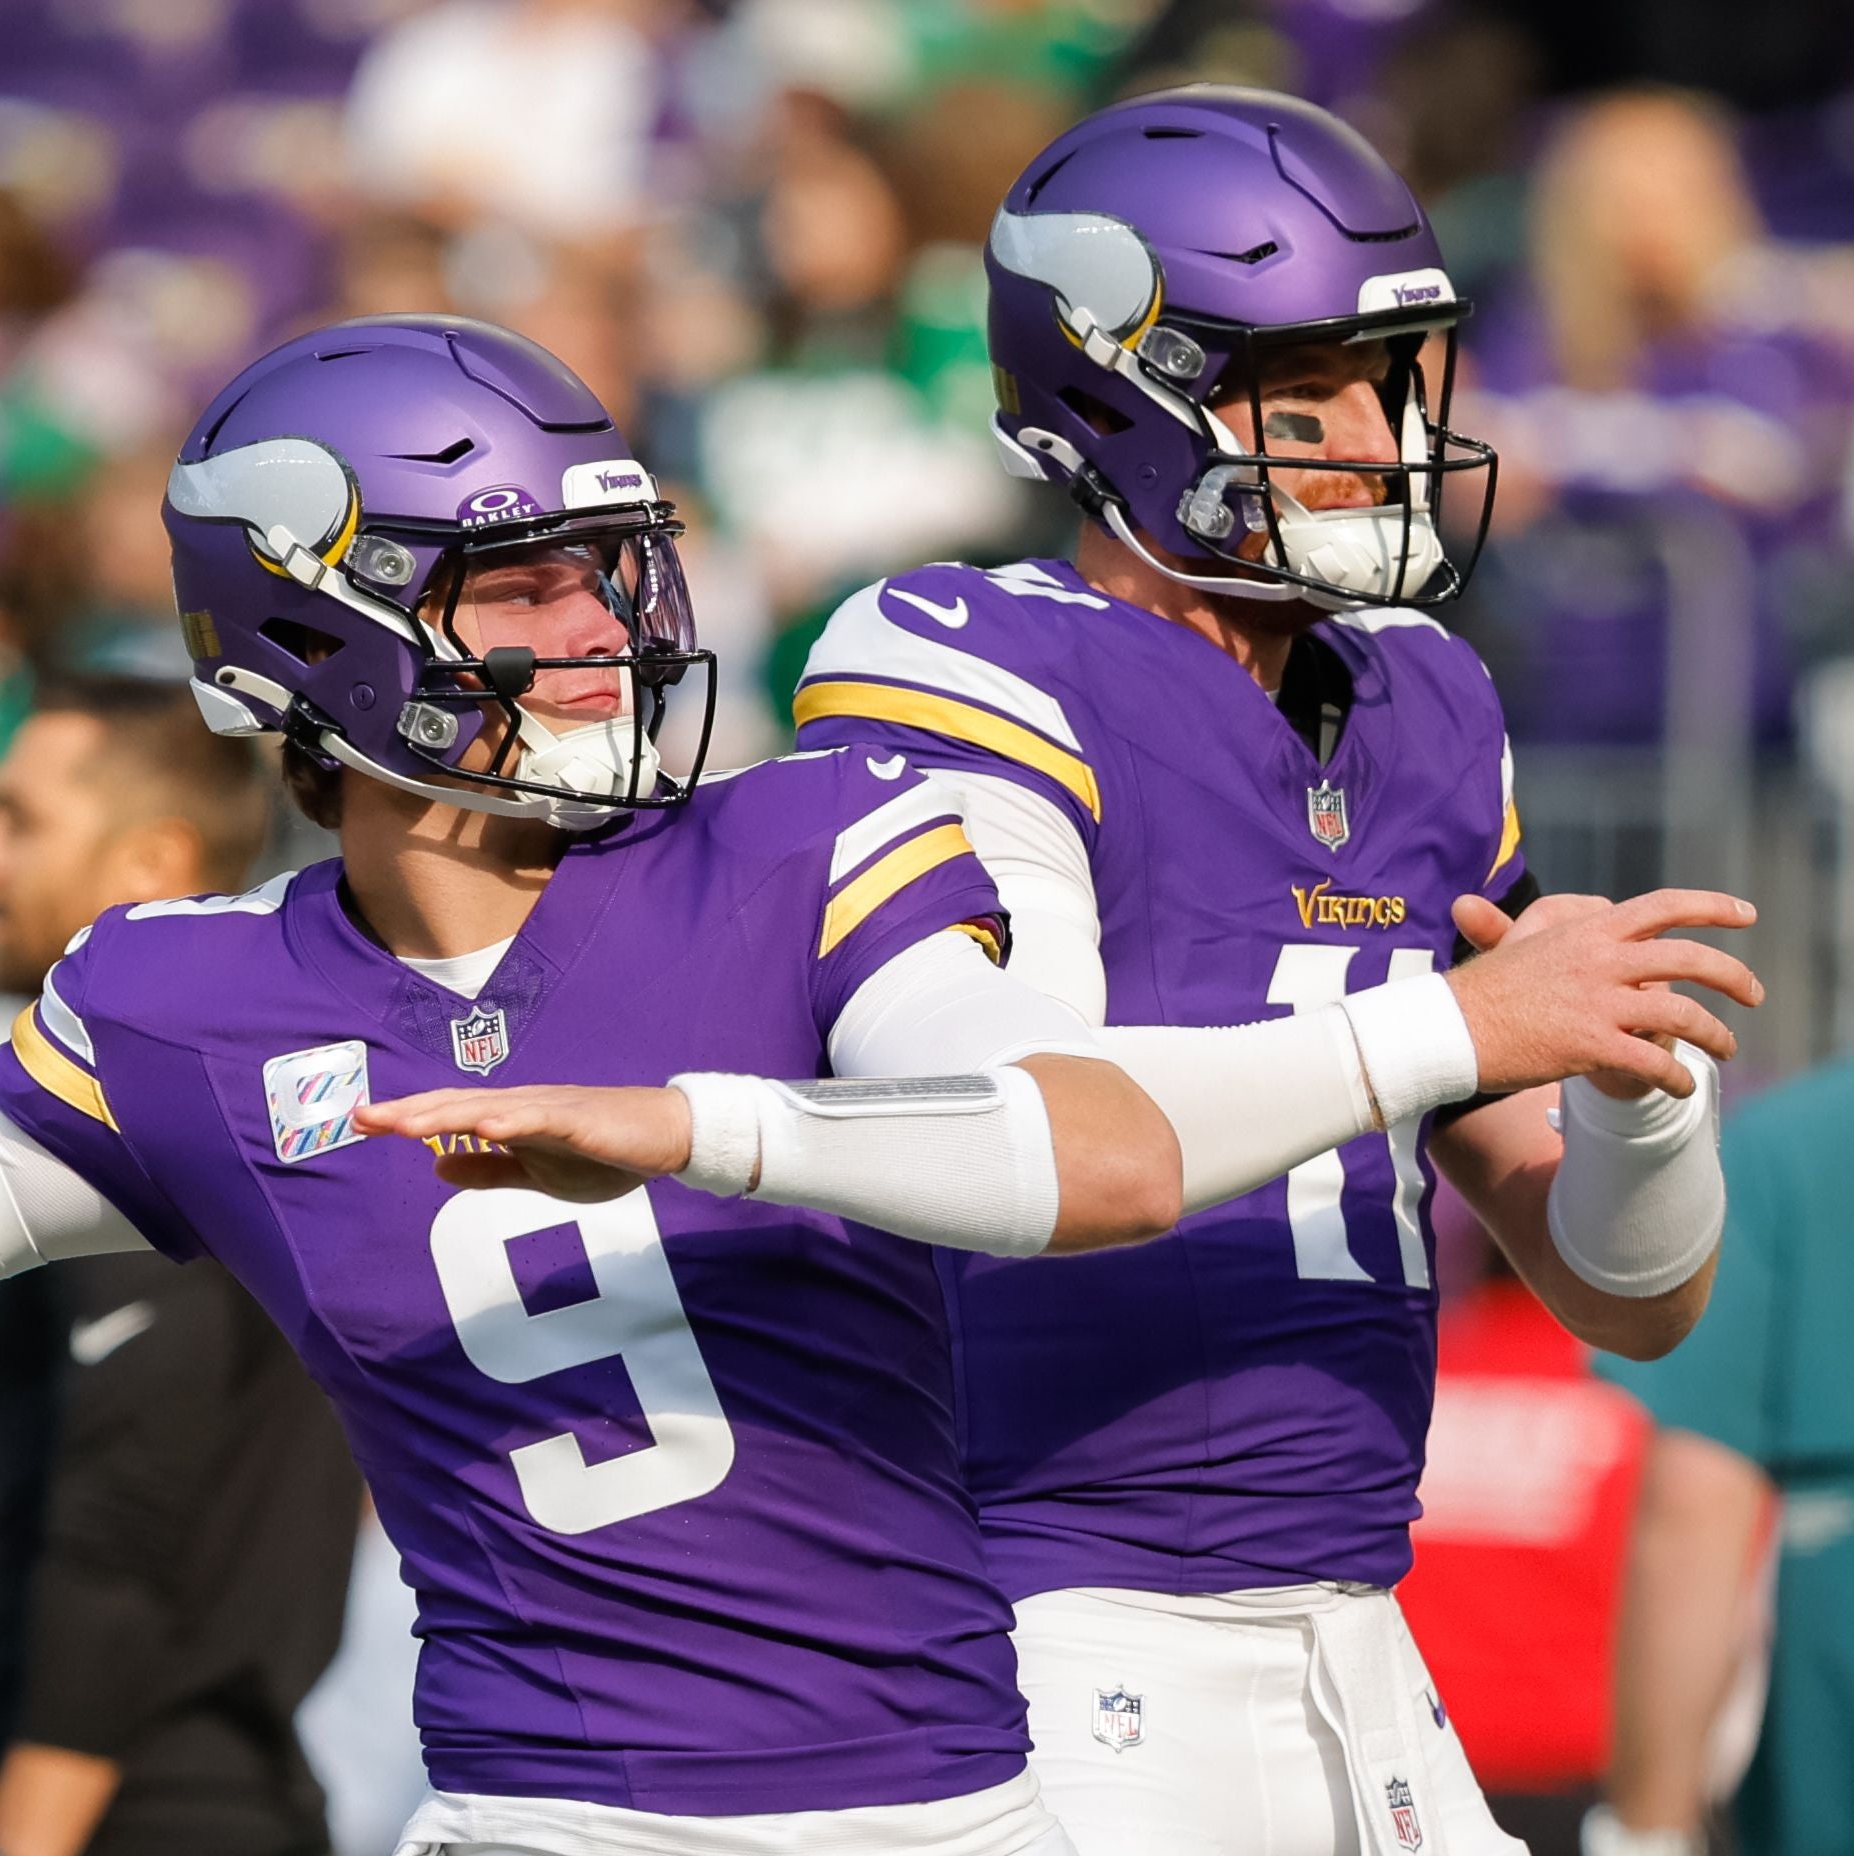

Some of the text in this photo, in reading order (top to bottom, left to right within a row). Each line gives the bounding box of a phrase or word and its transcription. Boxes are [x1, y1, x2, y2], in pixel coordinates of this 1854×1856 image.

[461, 503, 534, 528] OAKLEY
[1316, 813, 1345, 837] NFL
[461, 1036, 501, 1064] NFL
[429, 1184, 735, 1535] 9
[1104, 1713, 1138, 1738] NFL
[1392, 1809, 1420, 1844] NFL
